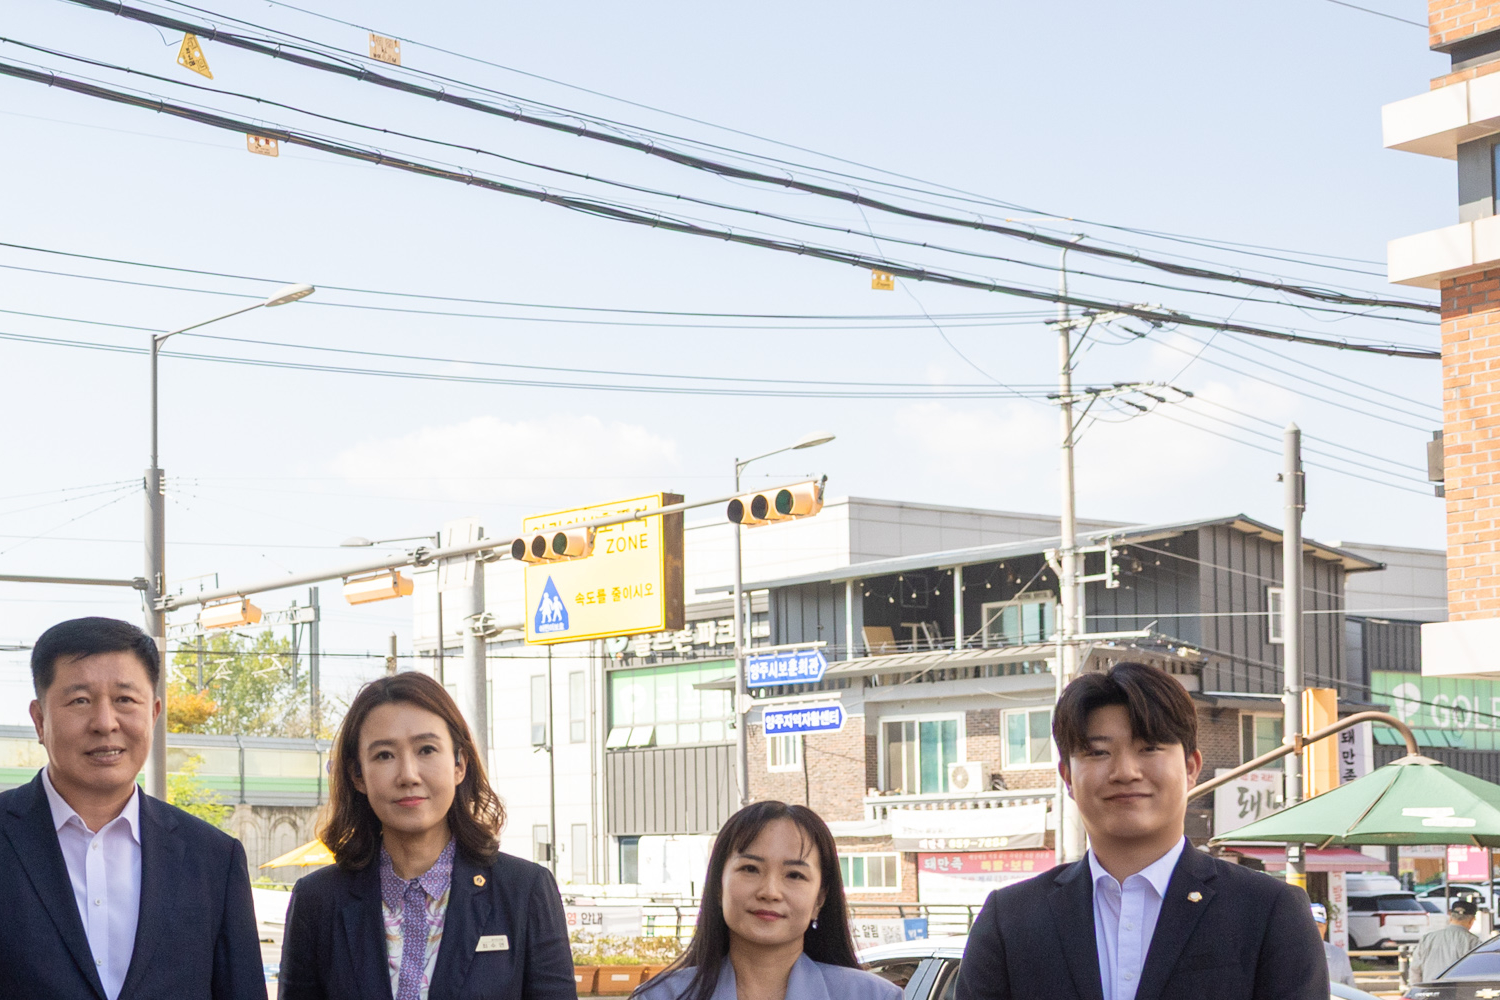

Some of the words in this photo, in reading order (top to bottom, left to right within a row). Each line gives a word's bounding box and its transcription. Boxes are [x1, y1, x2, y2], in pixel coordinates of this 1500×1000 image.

[606, 533, 648, 554] ZONE
[575, 588, 607, 606] 속도를
[611, 582, 654, 602] 줄이시오
[750, 656, 820, 681] 양주시보훈회관
[924, 856, 963, 871] 돼만족
[581, 912, 603, 926] 안내
[862, 924, 879, 938] 알림
